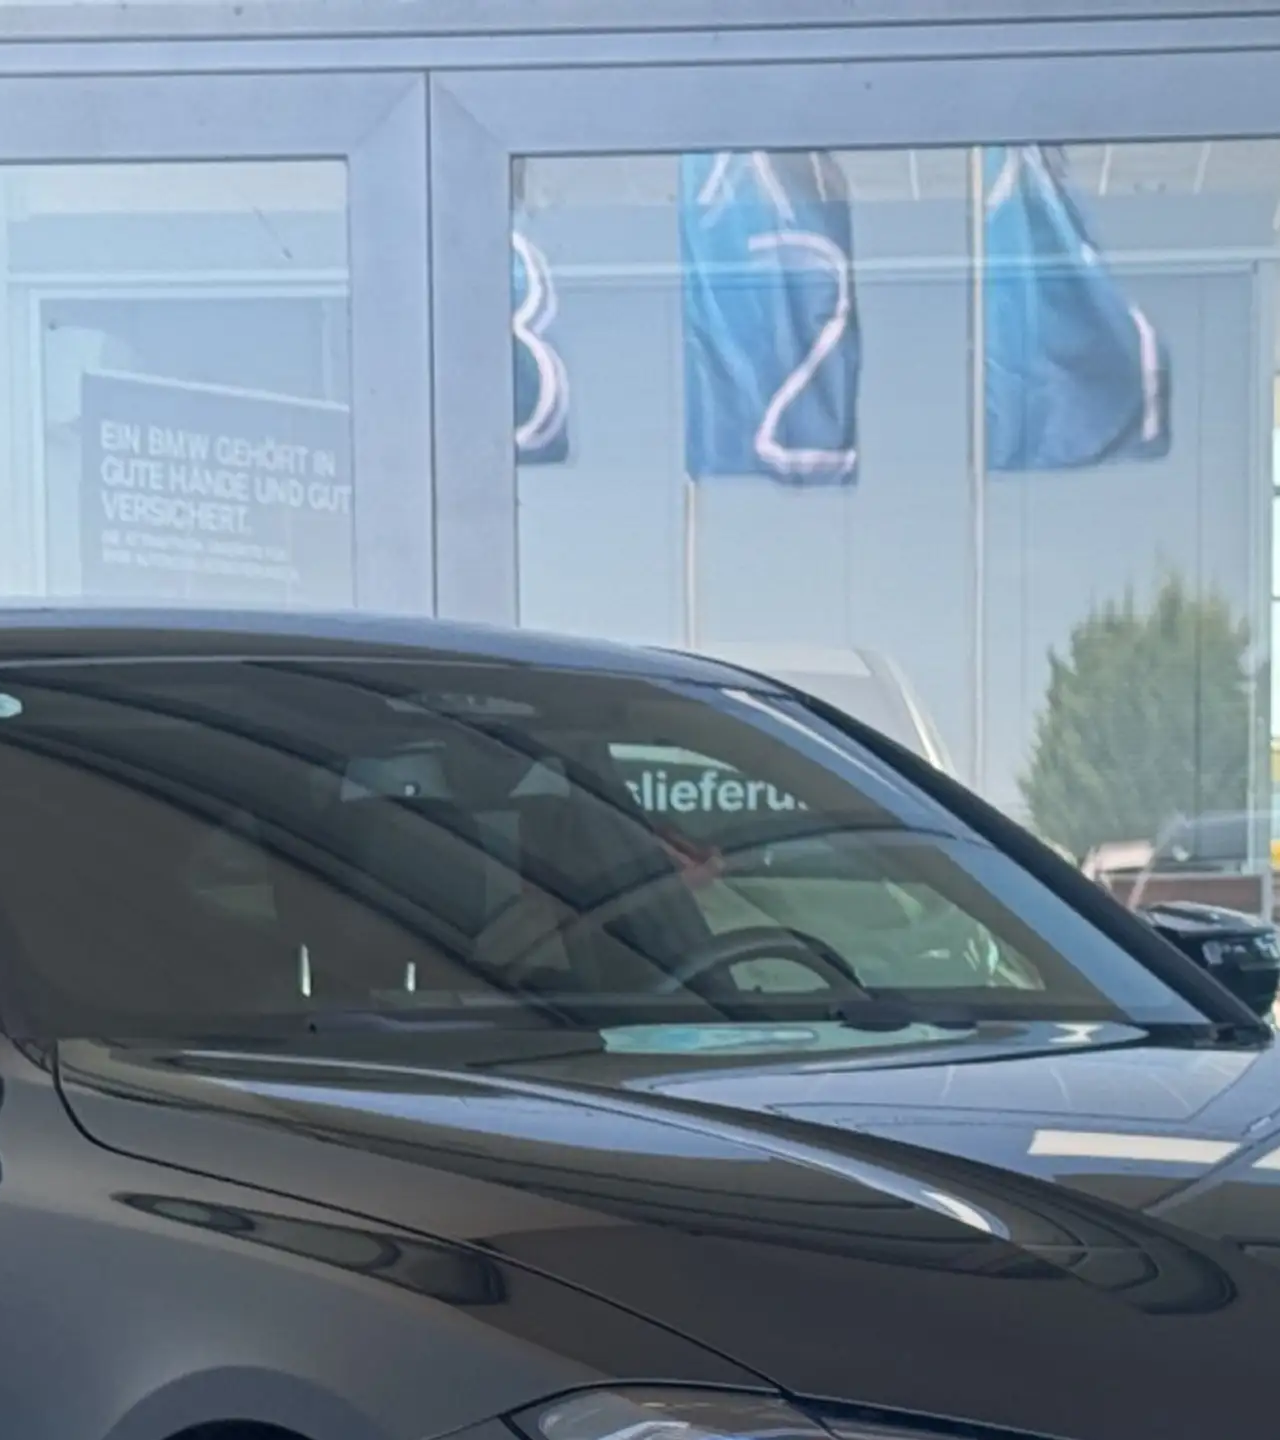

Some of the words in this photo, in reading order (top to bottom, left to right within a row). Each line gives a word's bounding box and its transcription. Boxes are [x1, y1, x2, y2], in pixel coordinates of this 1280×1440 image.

[748, 230, 857, 474] 2
[100, 418, 141, 454] EIN
[147, 424, 210, 461] BMW
[312, 449, 337, 478] IN
[100, 454, 164, 490] GUTE
[254, 476, 305, 508] UND
[625, 769, 808, 812] lieferu
